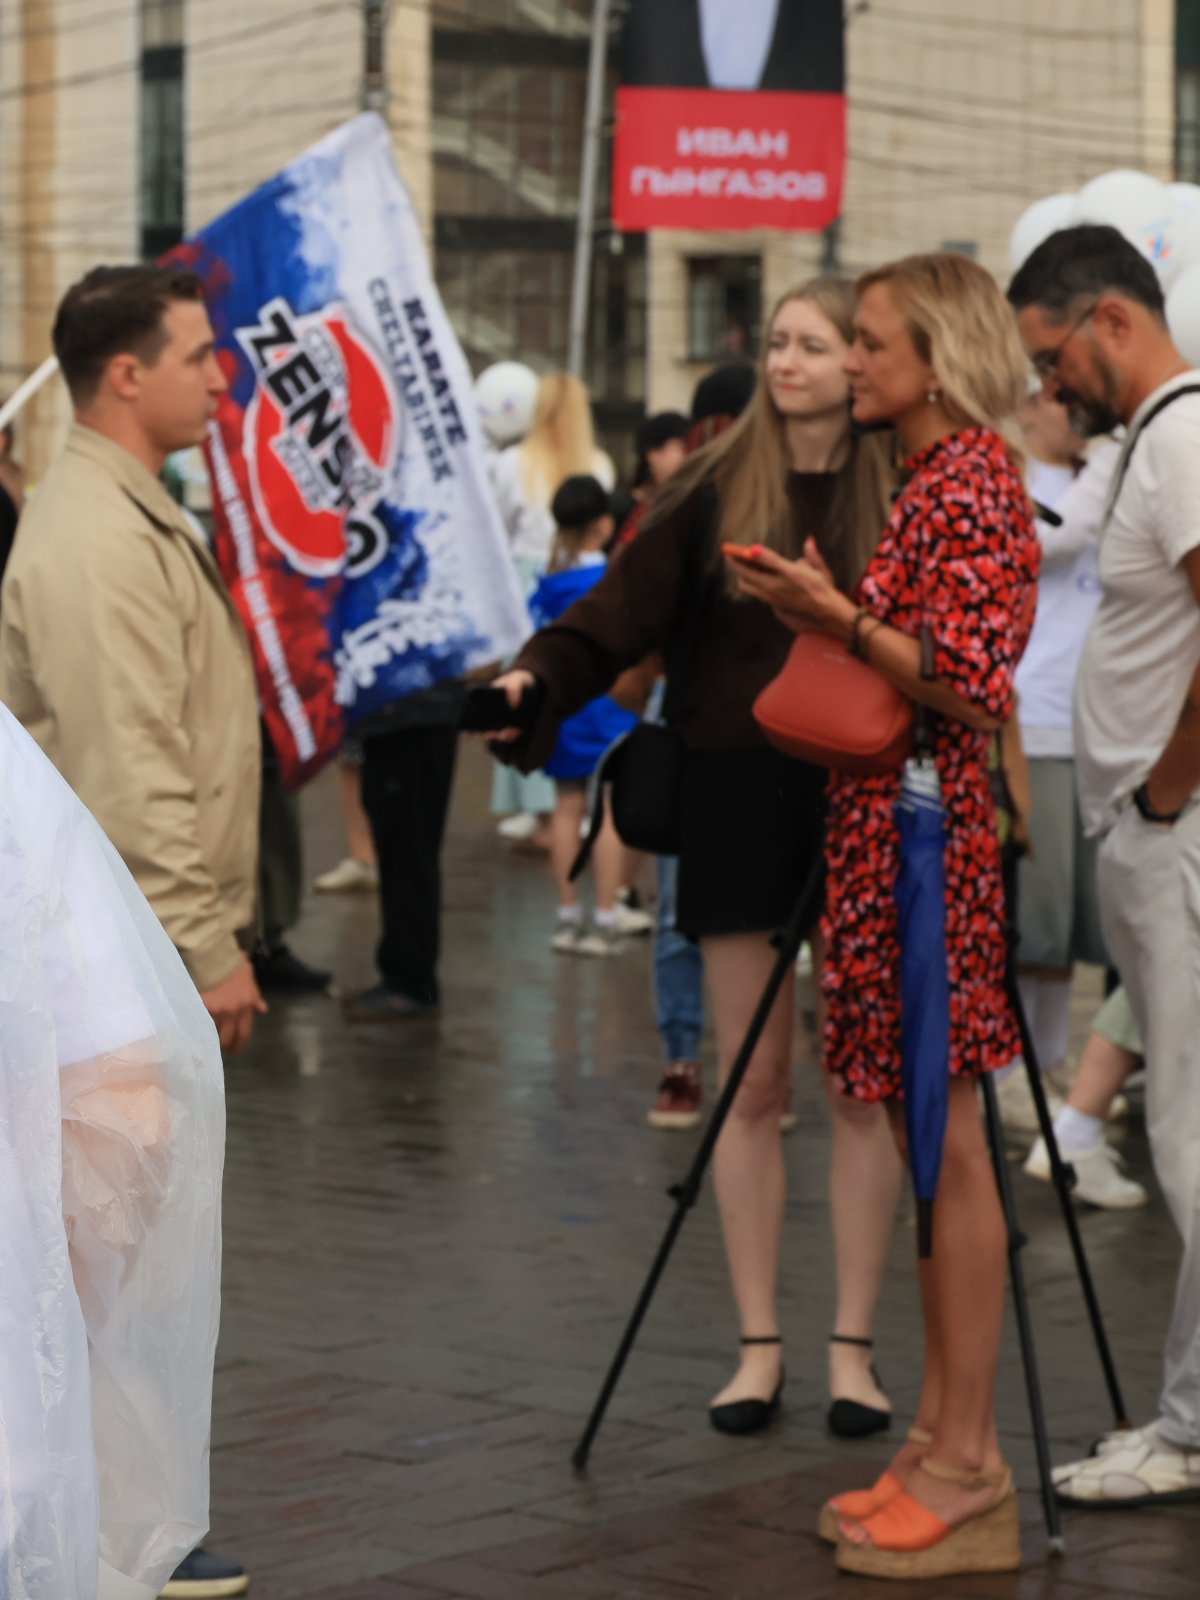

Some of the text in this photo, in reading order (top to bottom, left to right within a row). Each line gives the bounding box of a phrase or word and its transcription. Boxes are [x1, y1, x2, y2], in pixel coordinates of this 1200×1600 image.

[630, 166, 827, 200] ГЫНГАЗОВ
[676, 128, 789, 158] ИВАН
[402, 297, 468, 448] KARATE
[250, 310, 379, 568] ZENSO
